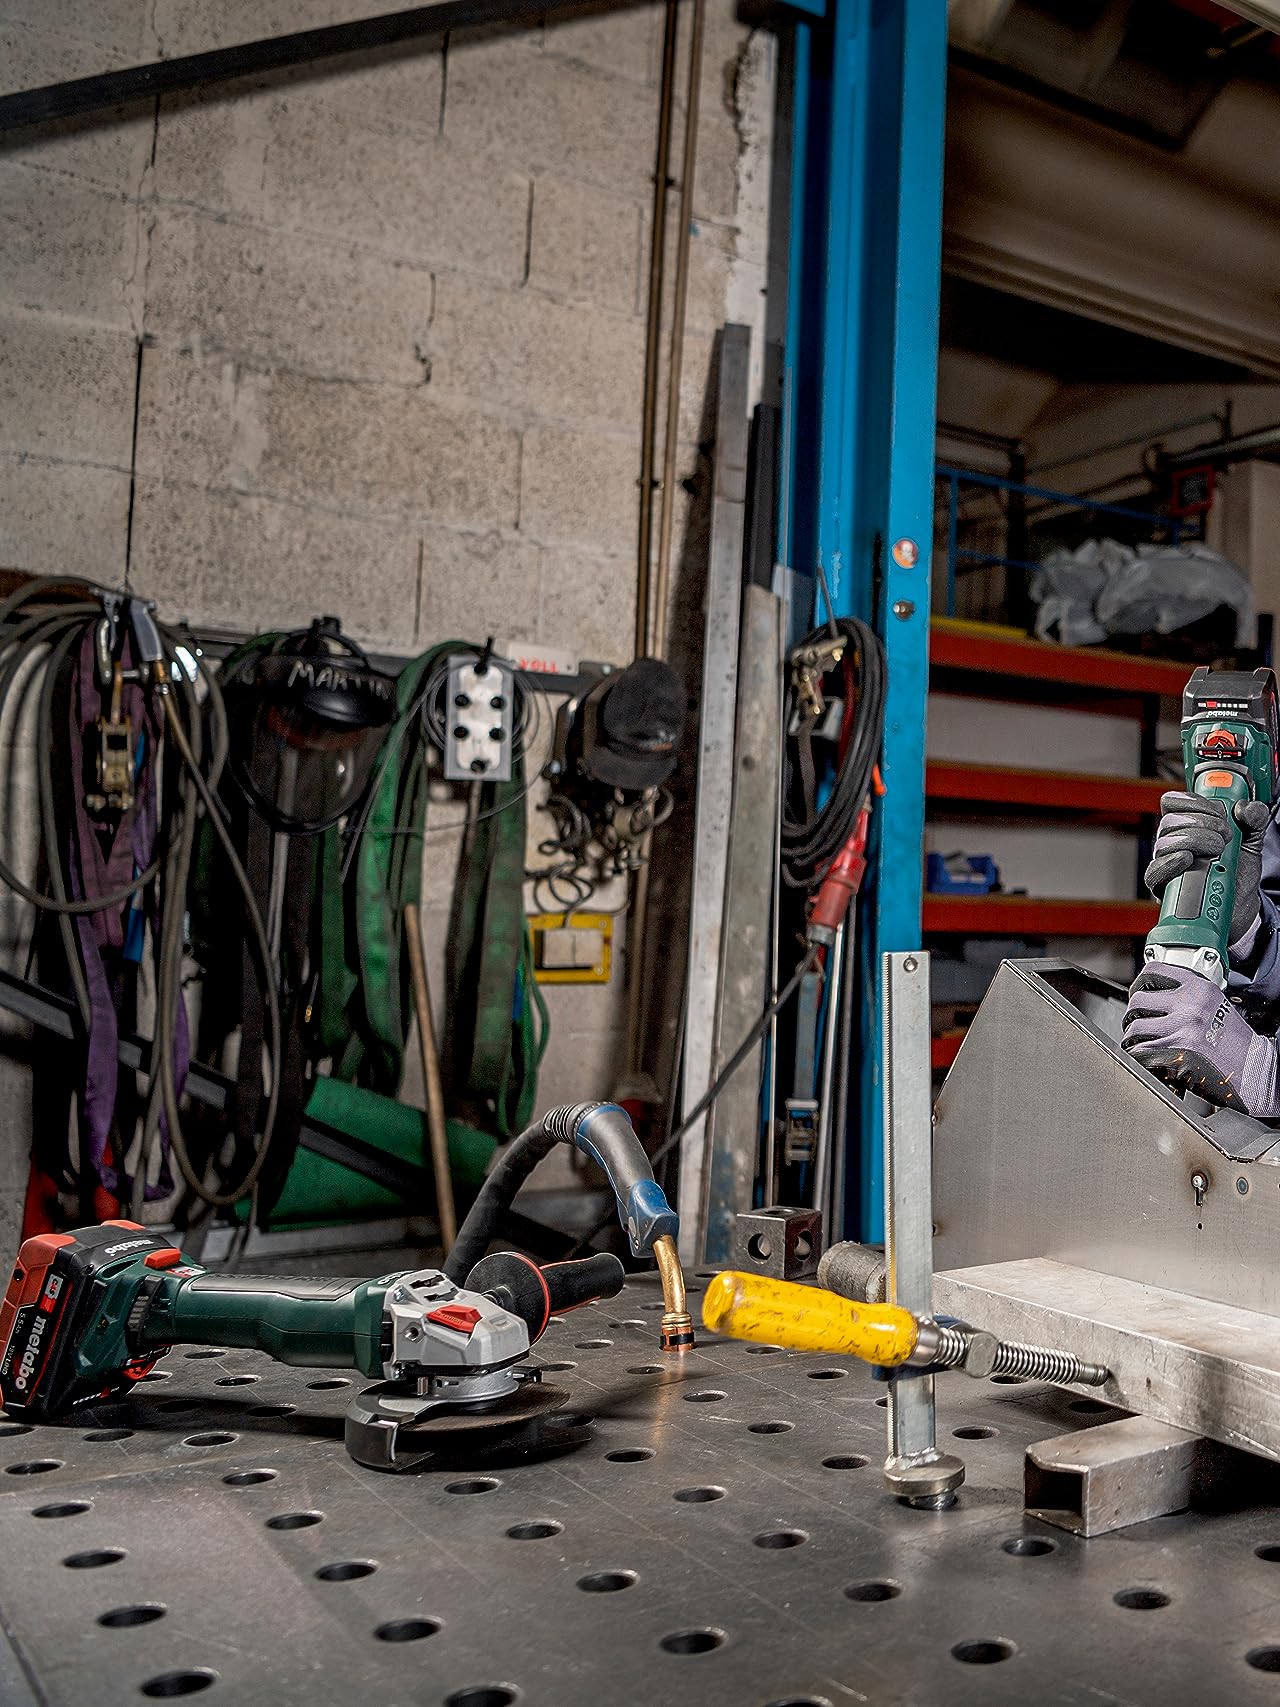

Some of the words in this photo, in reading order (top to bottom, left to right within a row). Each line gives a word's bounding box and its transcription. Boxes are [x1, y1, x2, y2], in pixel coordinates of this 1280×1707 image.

[1206, 710, 1238, 718] metabo
[105, 1239, 154, 1255] metabo
[15, 1315, 47, 1390] metabo
